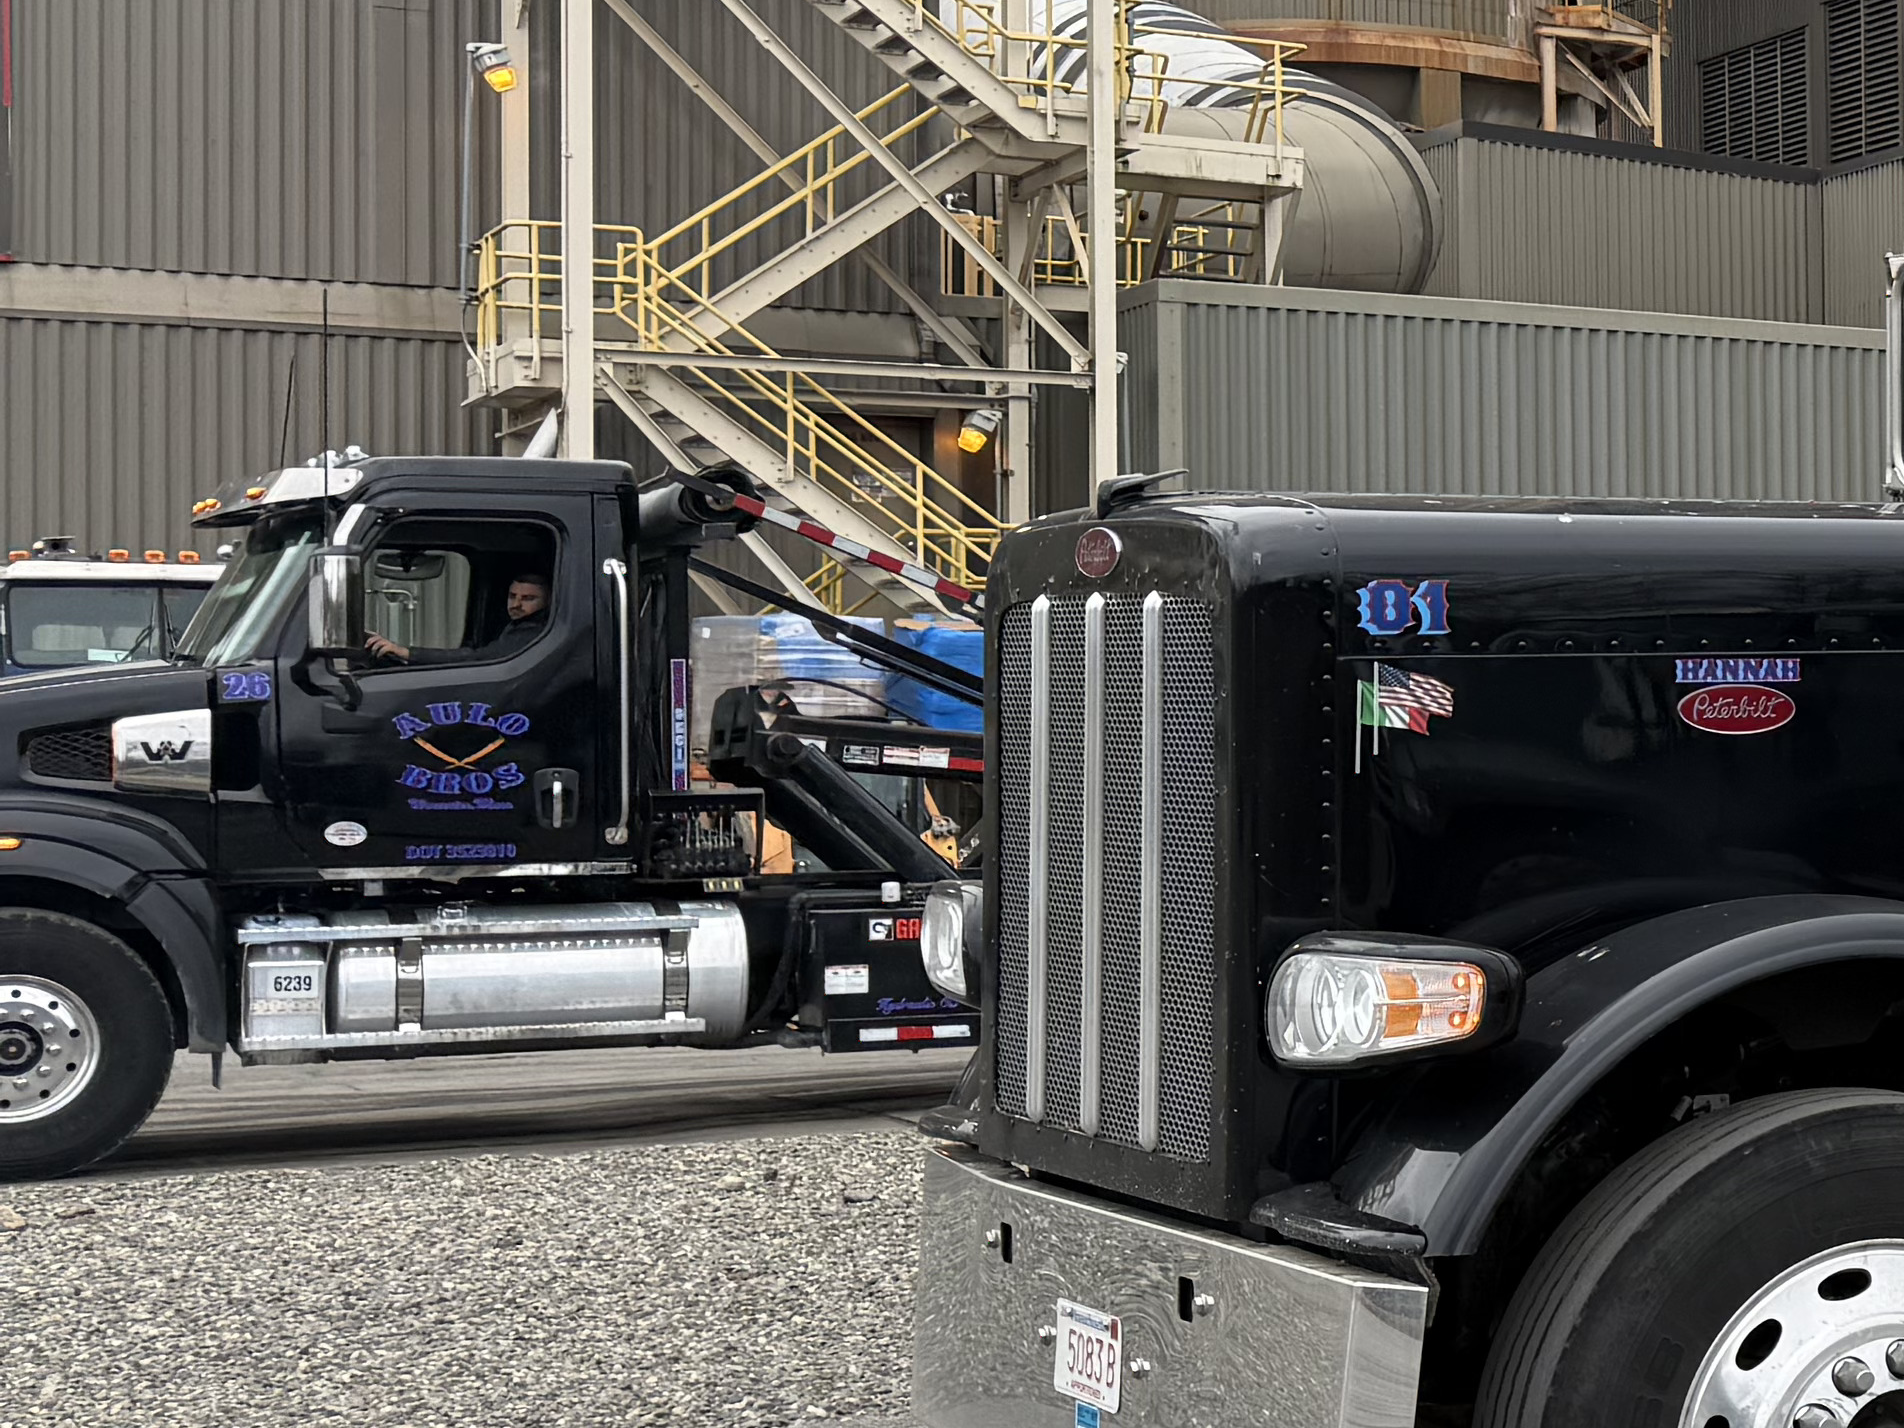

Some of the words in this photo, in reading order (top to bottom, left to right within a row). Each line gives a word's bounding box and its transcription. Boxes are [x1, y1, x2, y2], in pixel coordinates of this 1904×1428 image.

[1355, 579, 1452, 635] 01
[1675, 658, 1801, 683] HANNAH
[222, 672, 271, 700] 26
[392, 701, 530, 740] AULO
[1693, 693, 1785, 721] Peterbilt
[395, 762, 525, 794] BROS
[273, 975, 312, 992] 6239
